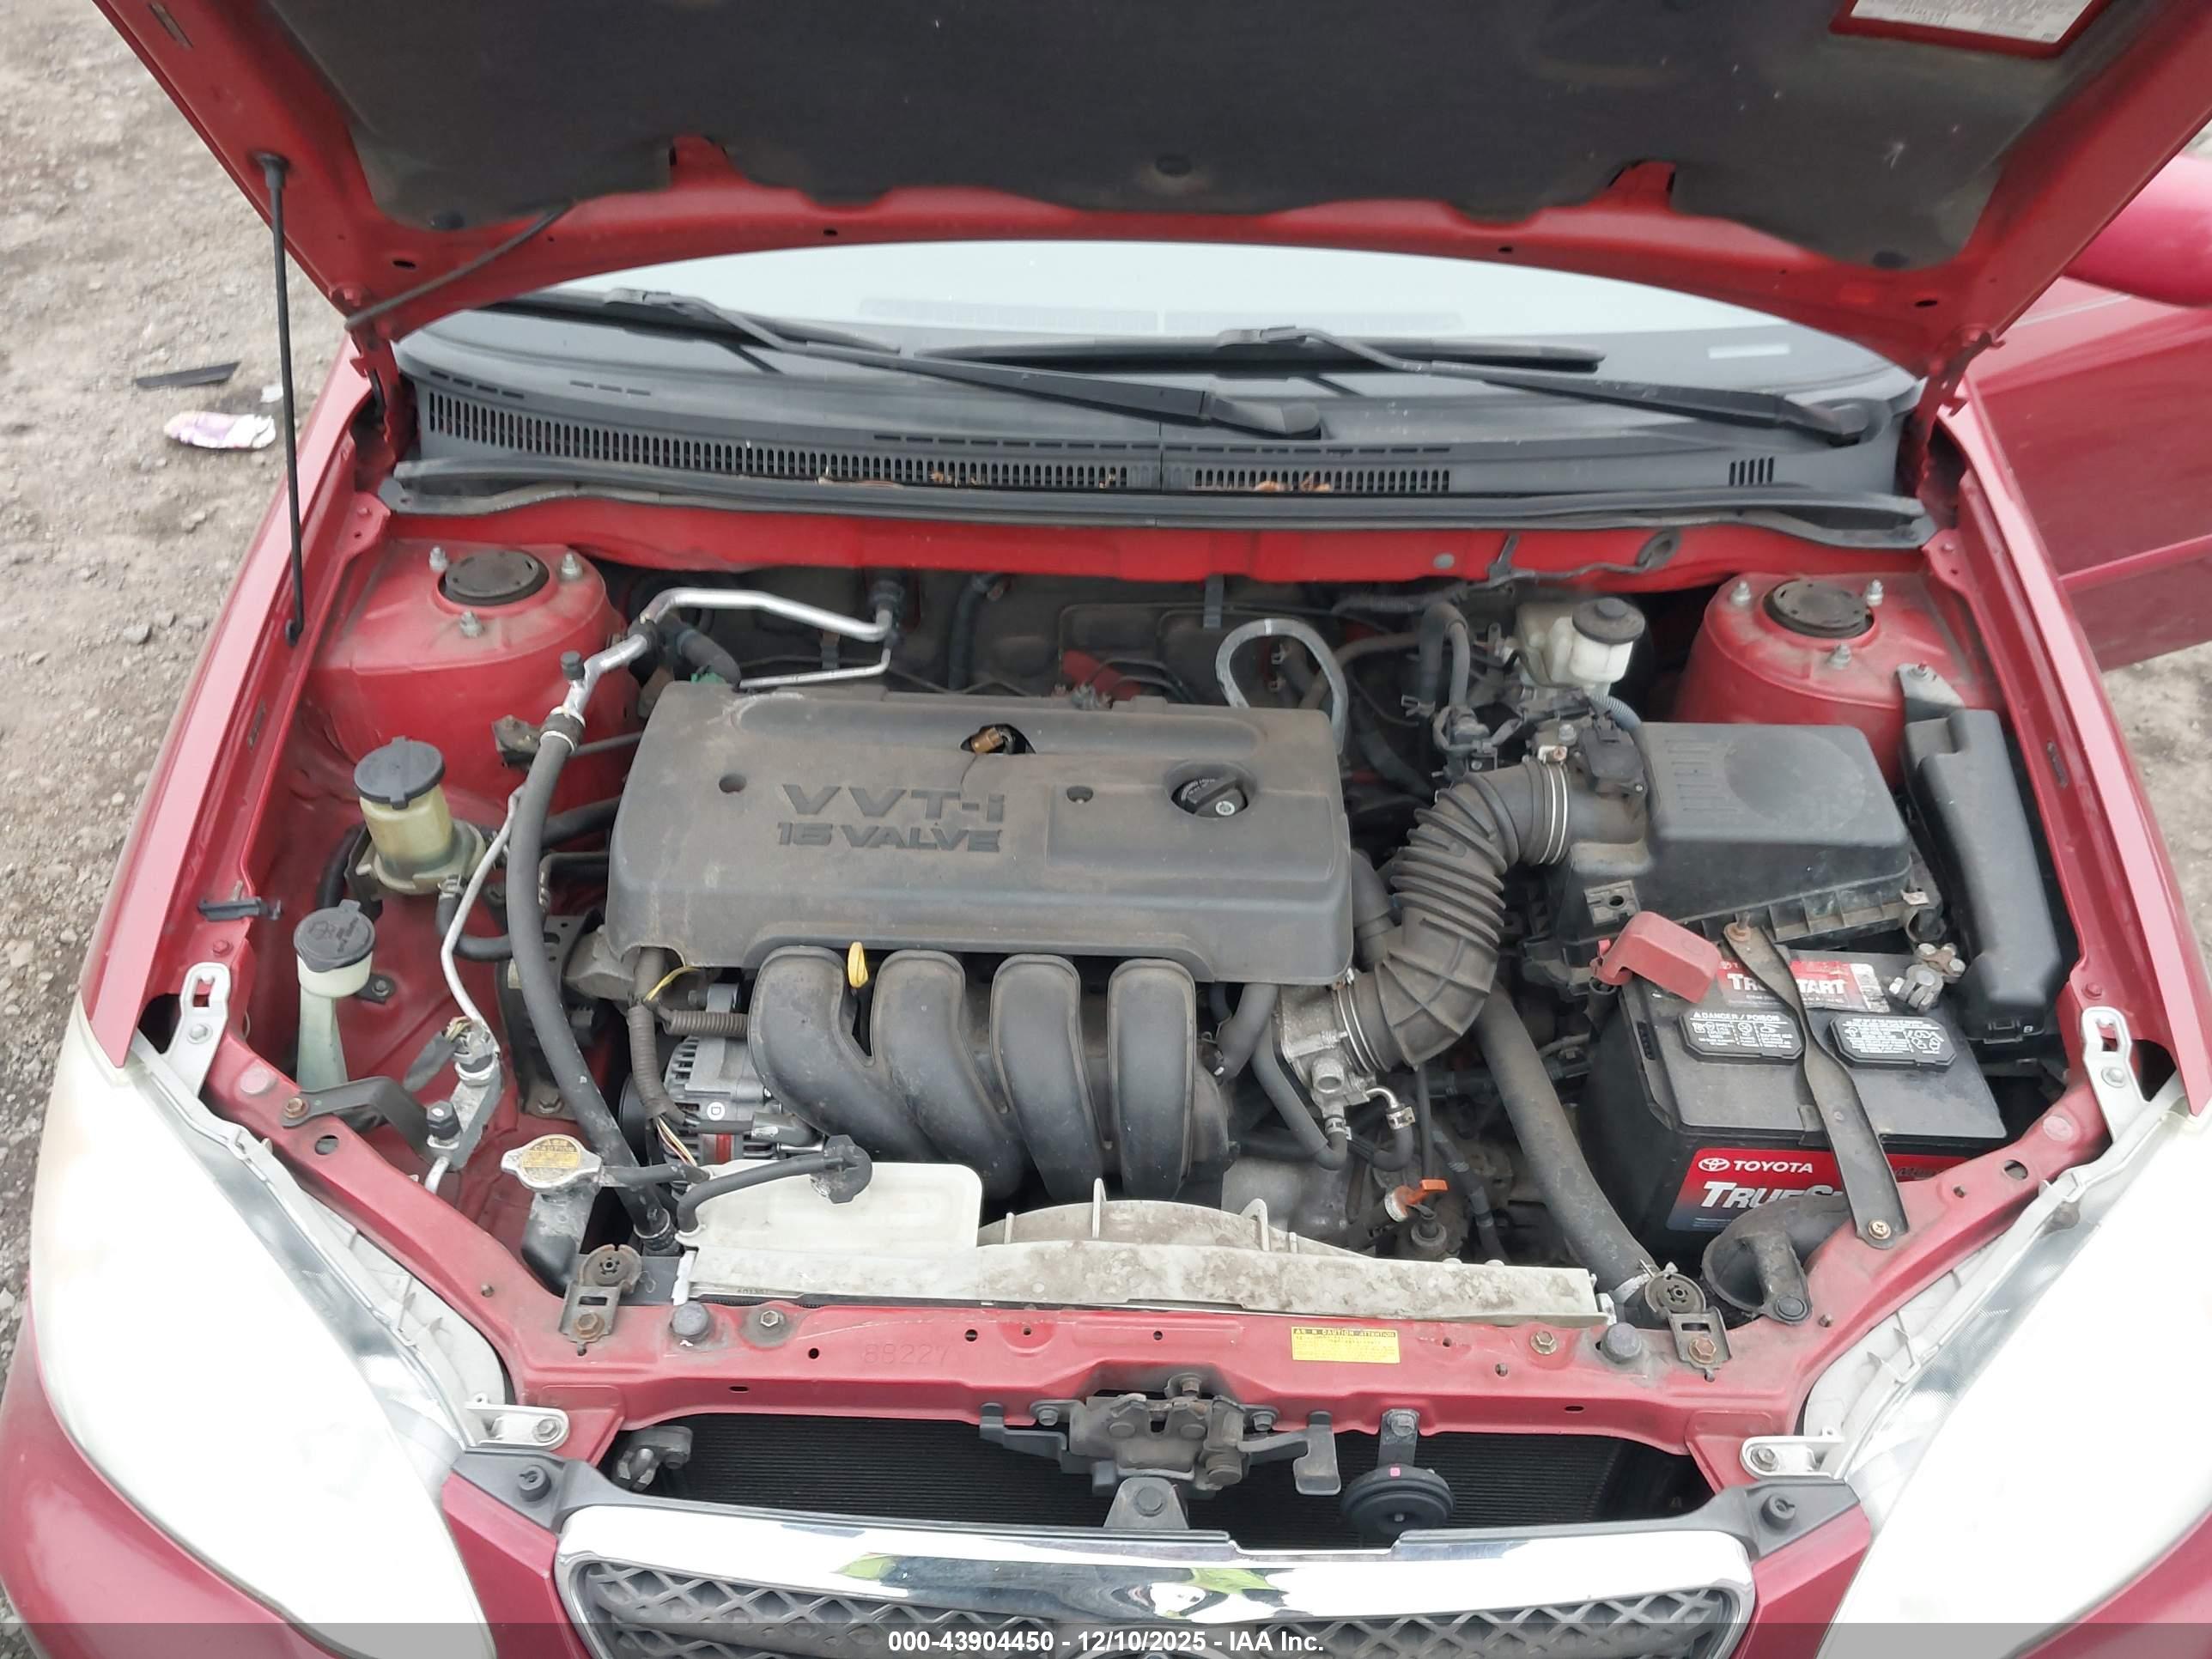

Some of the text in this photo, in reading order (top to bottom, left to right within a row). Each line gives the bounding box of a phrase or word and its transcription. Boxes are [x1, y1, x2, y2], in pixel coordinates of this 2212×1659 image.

[777, 822, 1003, 853] 16 VALVE
[1733, 1159, 1814, 1174] TOYOTA
